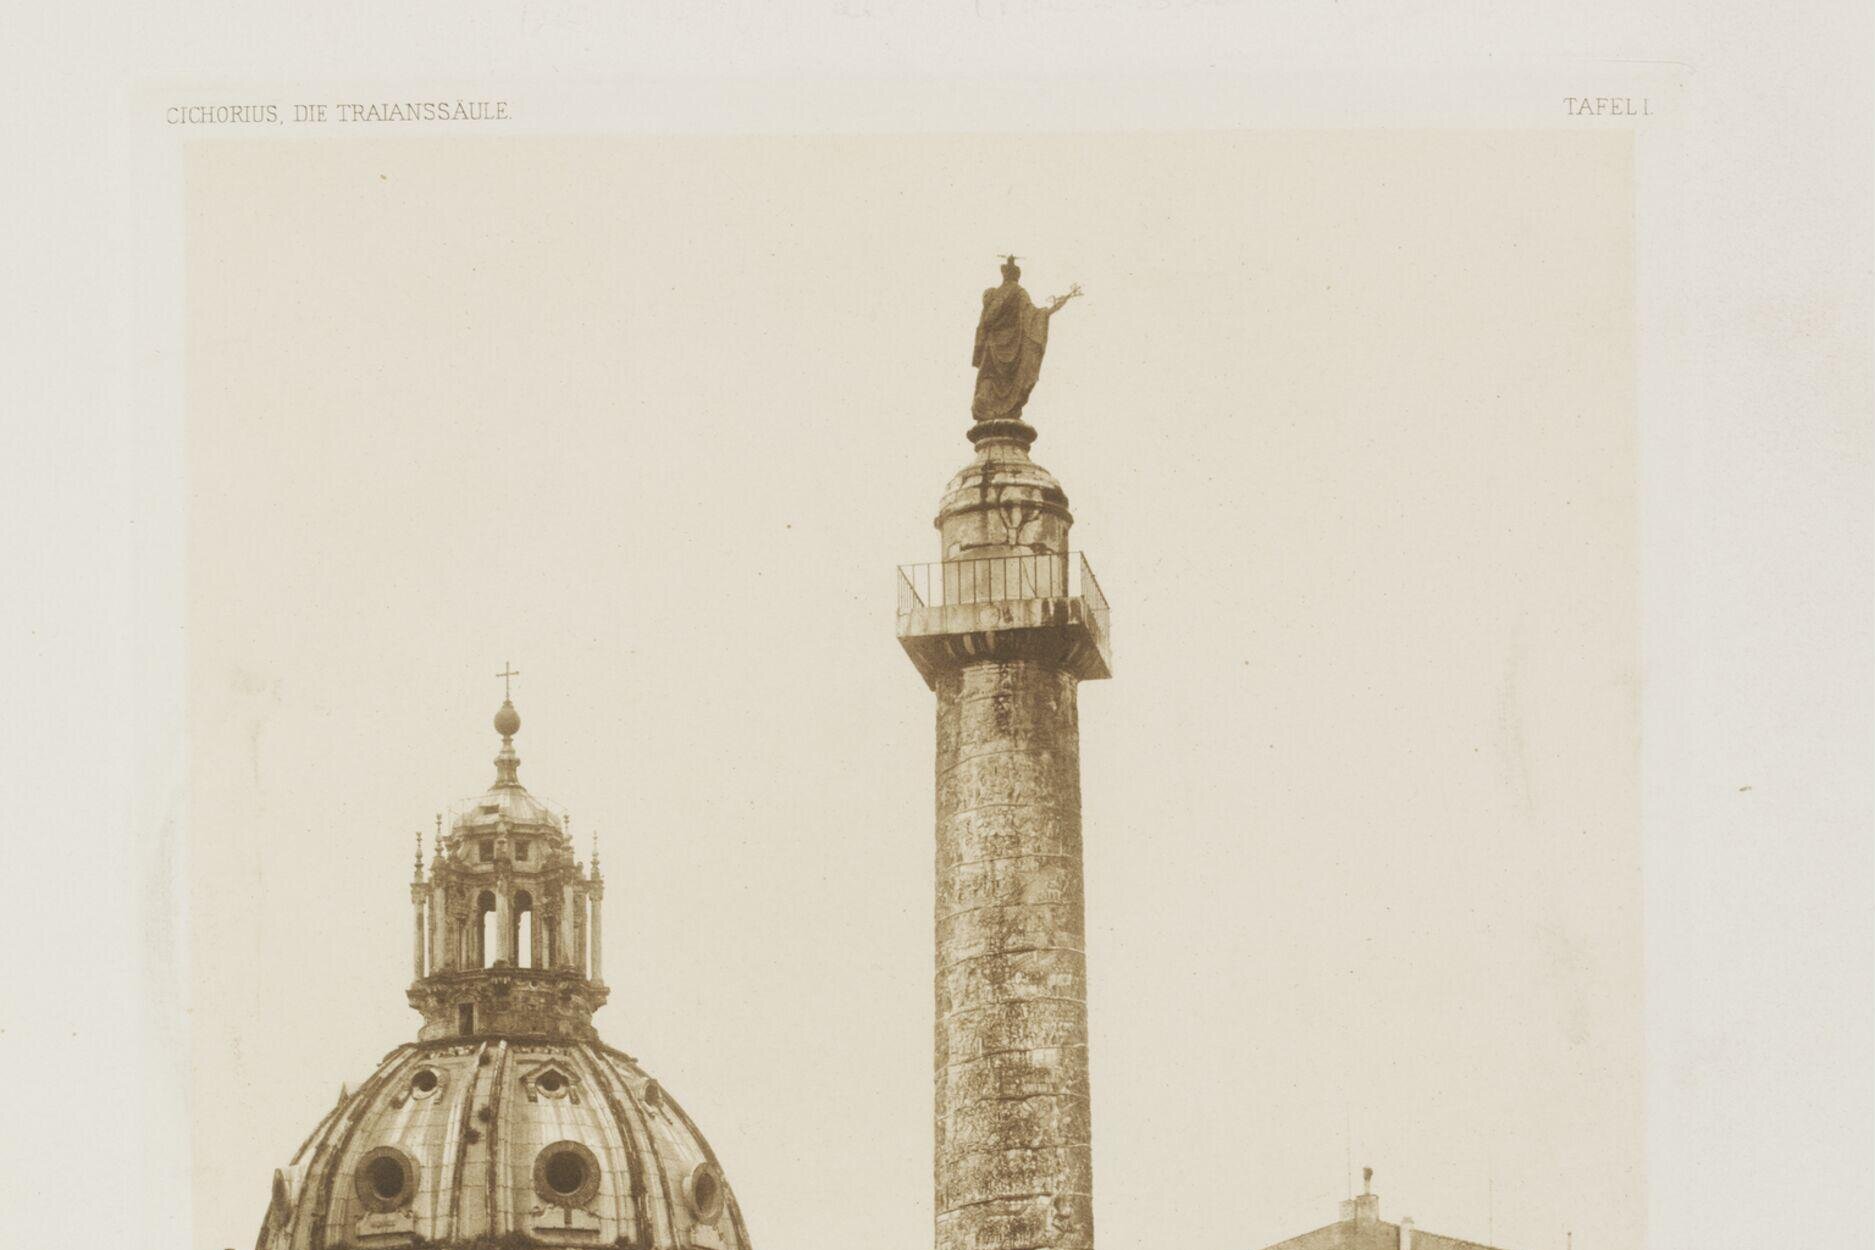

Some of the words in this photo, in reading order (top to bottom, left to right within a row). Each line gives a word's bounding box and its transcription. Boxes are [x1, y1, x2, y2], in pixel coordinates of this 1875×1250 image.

[167, 104, 285, 124] CICHORIUS,
[293, 103, 328, 122] DIE
[336, 99, 512, 121] TRAIANSSÄULE.
[1563, 97, 1638, 115] TAFEL
